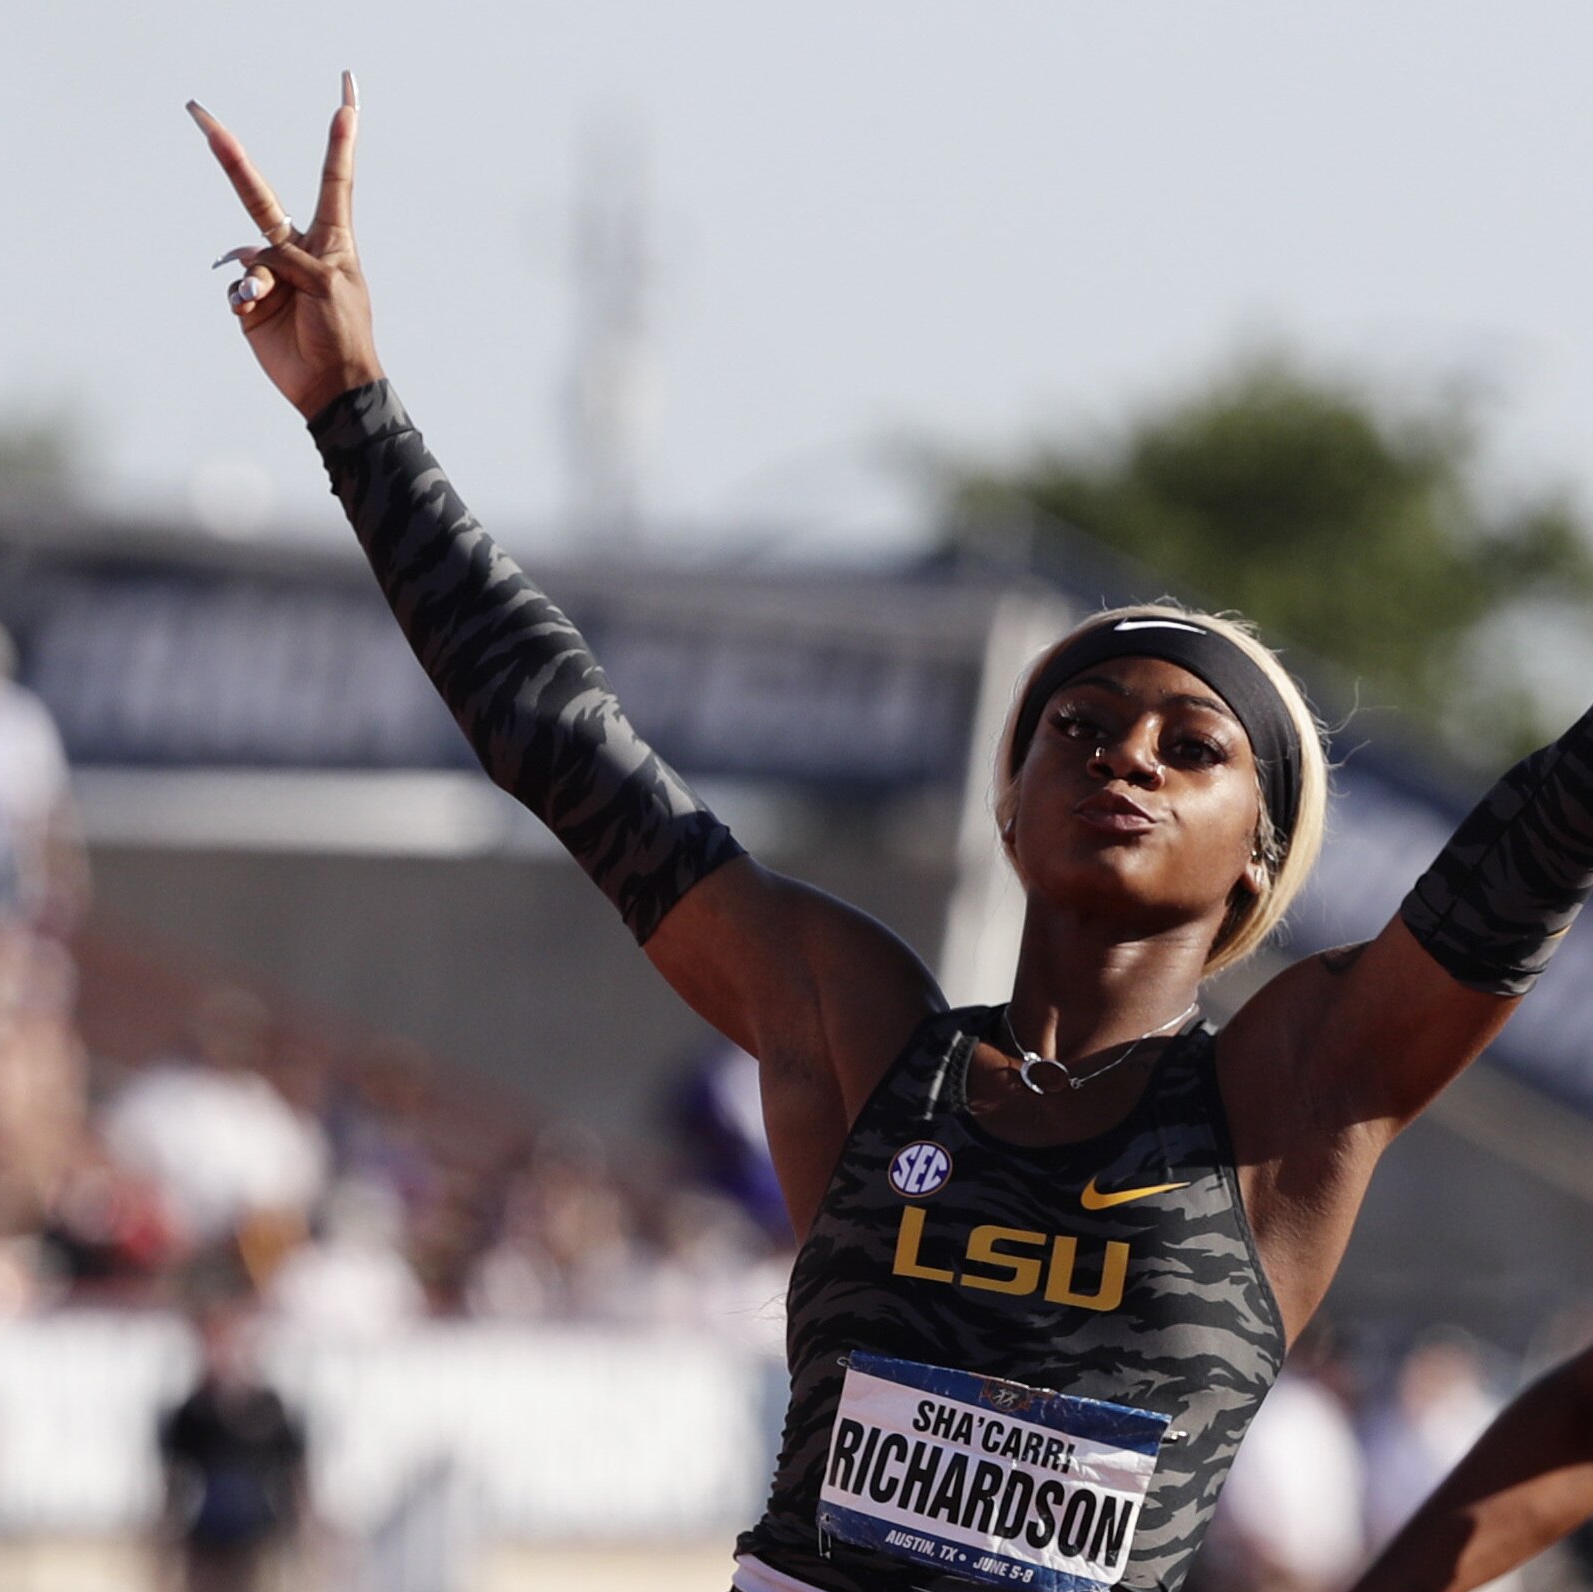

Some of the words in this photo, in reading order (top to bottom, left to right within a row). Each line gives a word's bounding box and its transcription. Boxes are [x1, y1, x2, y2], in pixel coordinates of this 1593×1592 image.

[892, 1144, 948, 1194] SEC
[892, 1205, 1130, 1312] LSU
[912, 1401, 1074, 1473] SHA'CARRI
[828, 1418, 1133, 1567] RICHARDSON
[885, 1530, 935, 1556] AUSTIN,
[972, 1556, 1010, 1578] JUNE
[1010, 1567, 1034, 1583] 5-8
